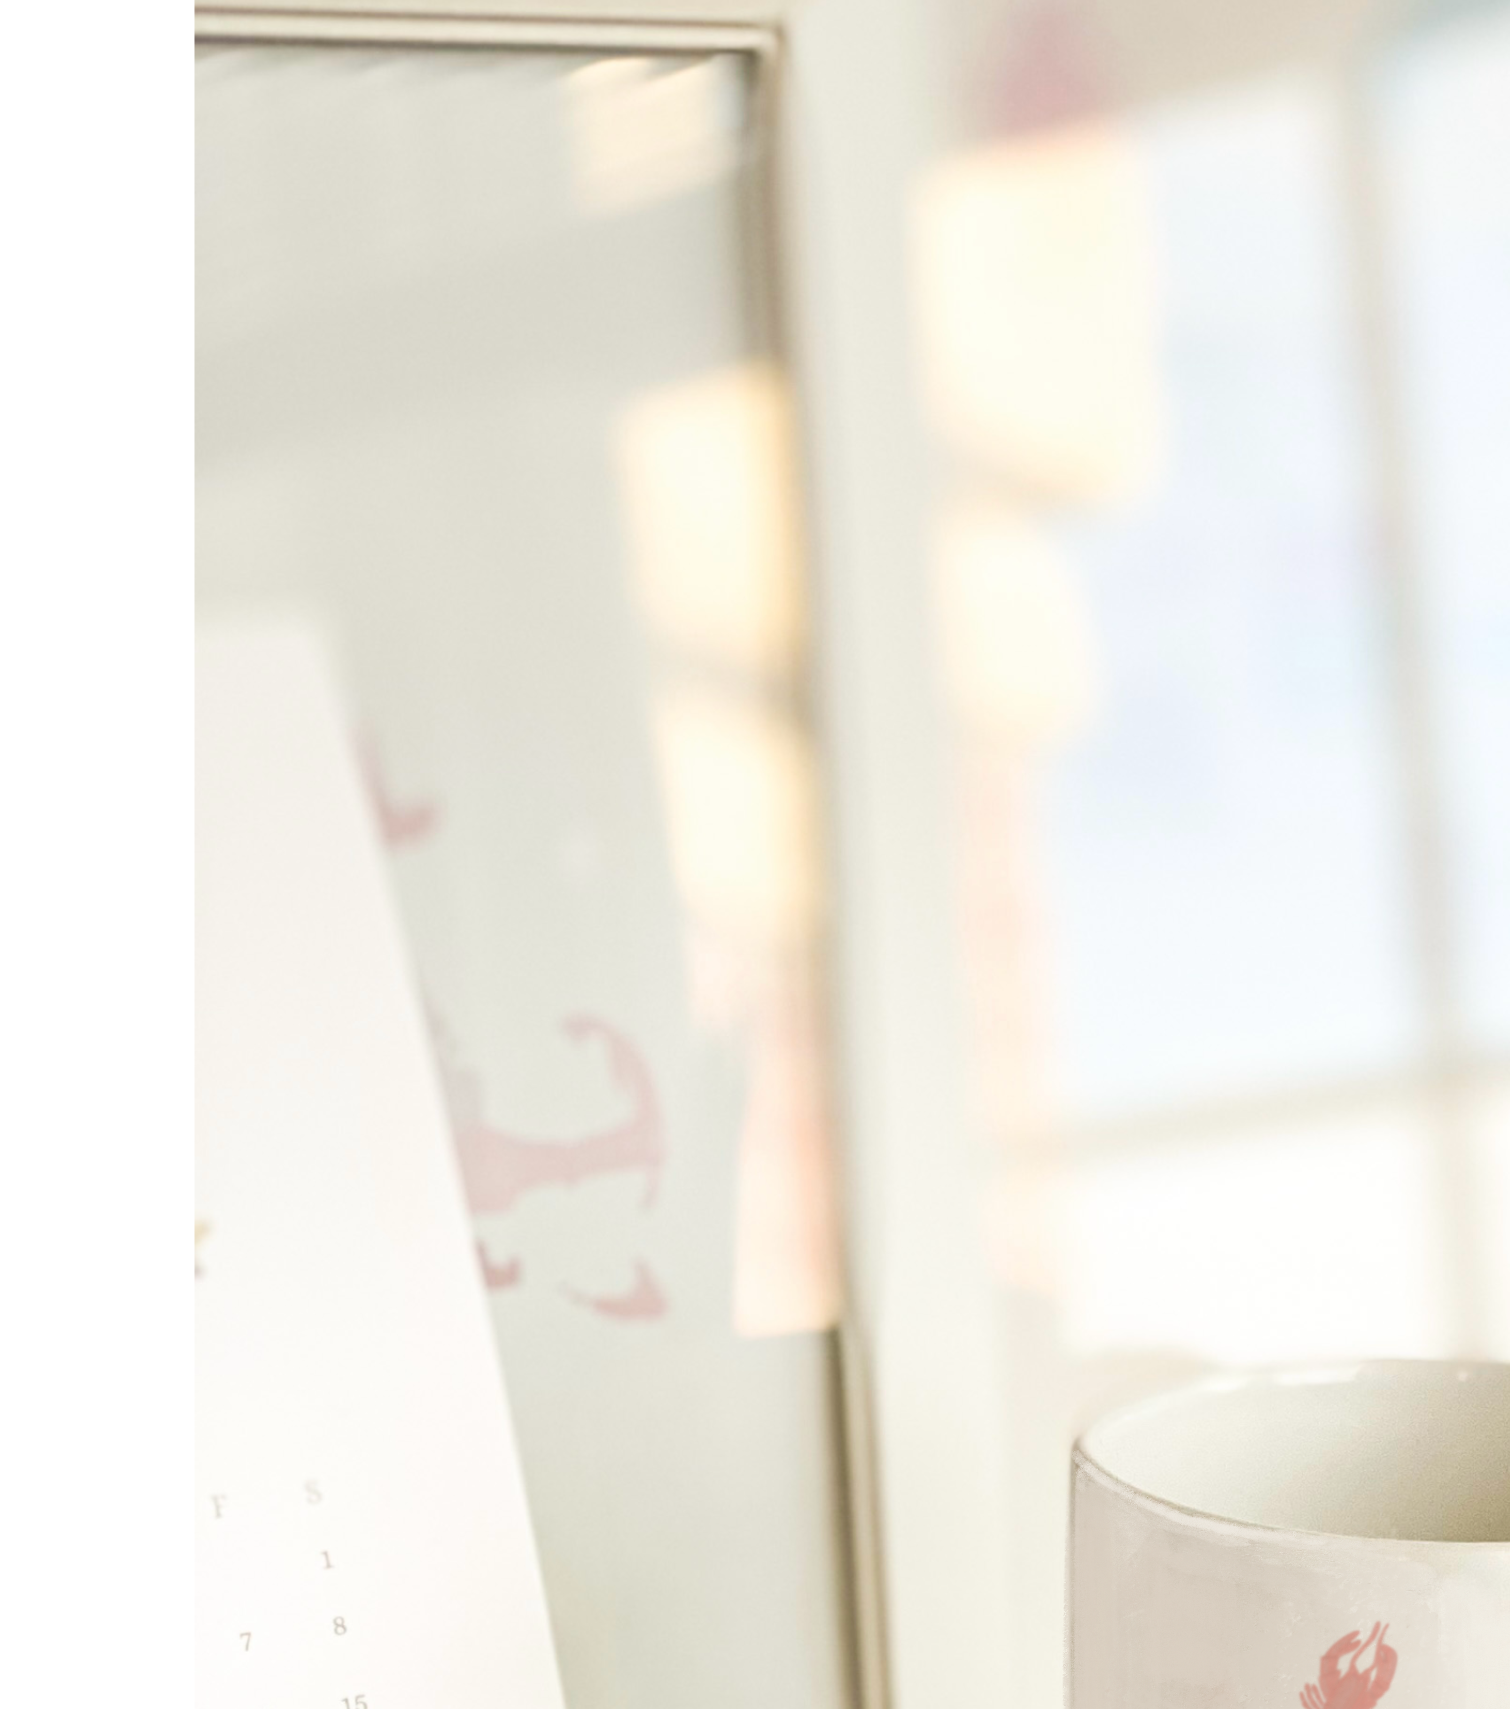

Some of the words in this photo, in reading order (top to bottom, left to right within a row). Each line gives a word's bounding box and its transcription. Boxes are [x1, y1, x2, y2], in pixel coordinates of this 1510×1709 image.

[320, 1550, 335, 1570] 1
[239, 1632, 253, 1652] 7
[332, 1616, 348, 1636] 8
